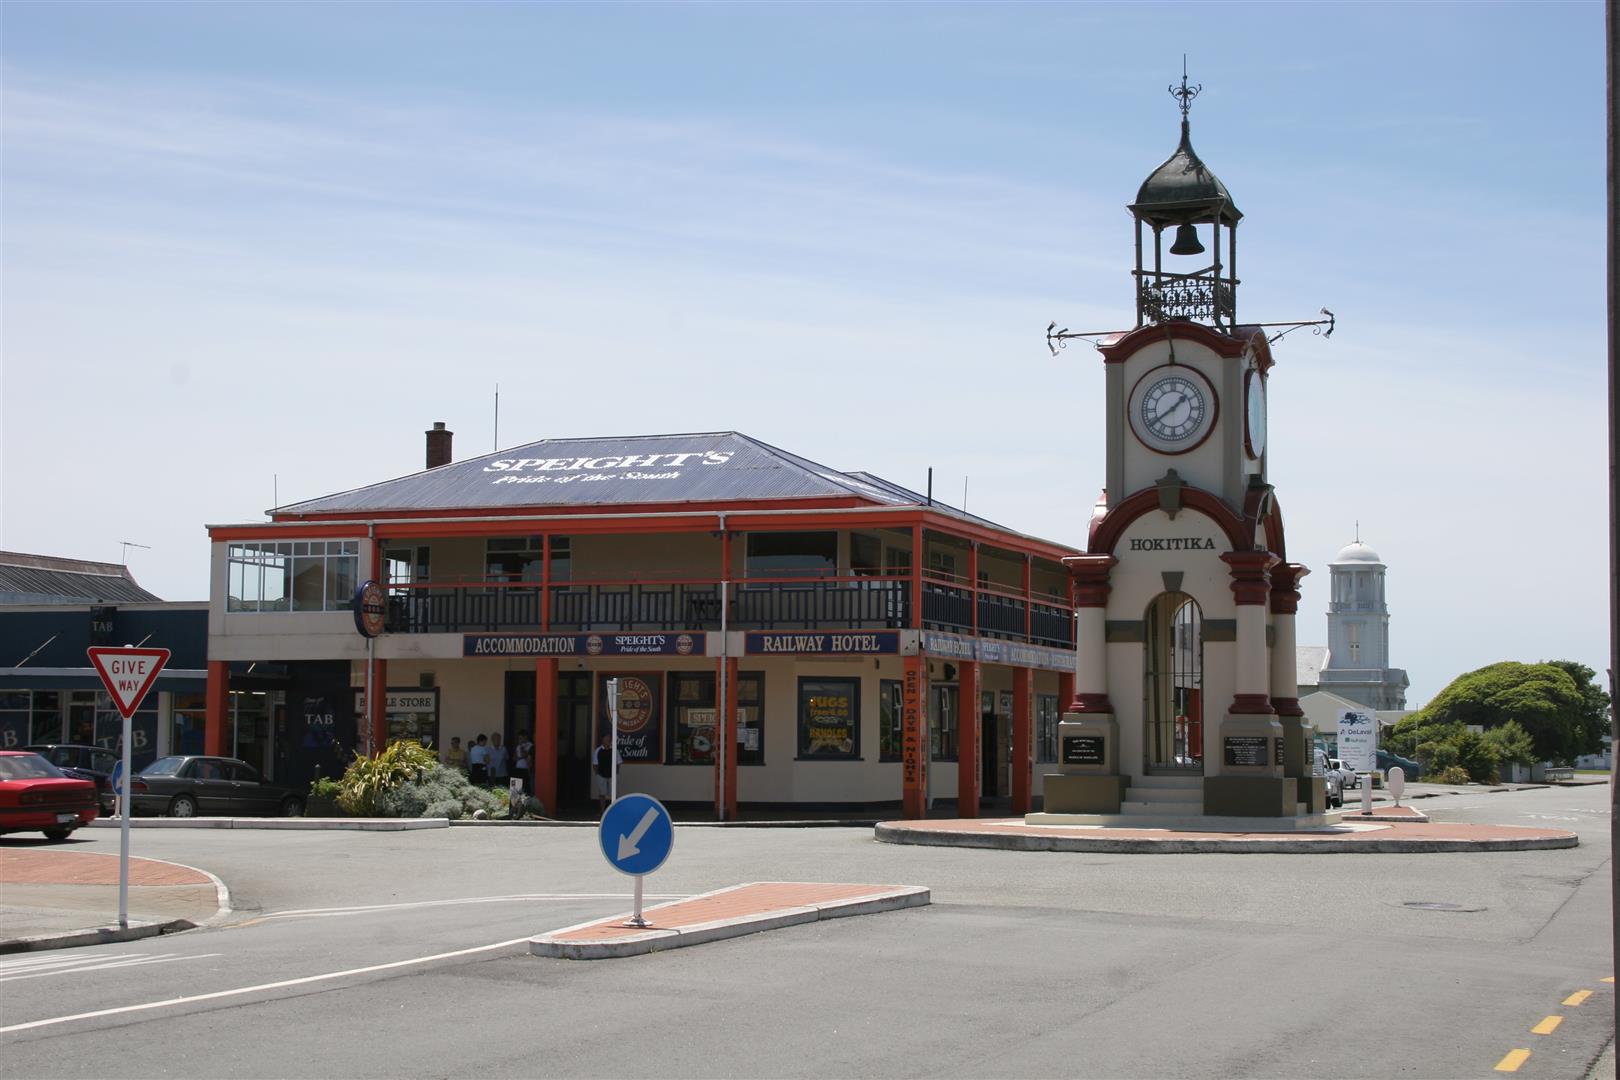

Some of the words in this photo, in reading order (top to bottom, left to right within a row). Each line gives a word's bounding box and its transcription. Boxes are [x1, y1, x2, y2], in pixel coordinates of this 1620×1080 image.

[483, 450, 735, 472] SPEIGHT'S
[492, 475, 551, 484] Pride
[555, 473, 580, 484] of
[581, 473, 616, 482] the
[620, 471, 681, 480] South
[1130, 537, 1216, 551] HOKITIKA
[91, 621, 113, 632] TAB
[475, 637, 575, 654] ACCOMMODATION
[615, 635, 665, 645] SPEIGHT'S
[763, 635, 824, 652] RAILWAY
[831, 635, 880, 652] HOTEL
[620, 645, 633, 653] Pride
[647, 645, 662, 653] South
[111, 661, 146, 674] GIVE
[118, 679, 140, 691] WAY
[905, 670, 916, 694] OPEN
[399, 697, 431, 708] STORE
[303, 713, 334, 725] TAB
[905, 708, 916, 733] DAYS
[616, 735, 635, 746] ride
[635, 735, 646, 748] of
[623, 746, 648, 758] South
[904, 746, 916, 783] NIGHTS
